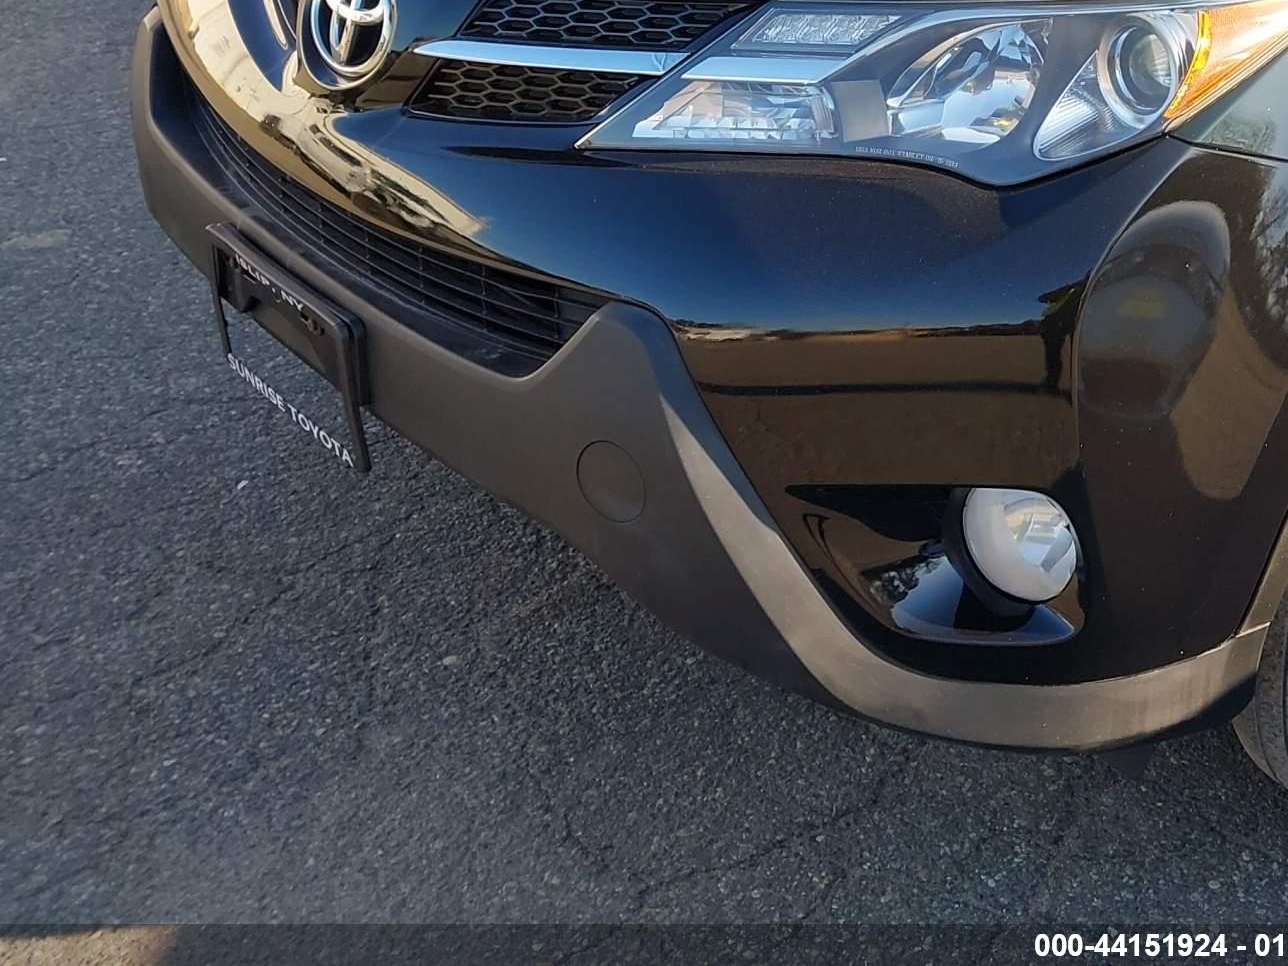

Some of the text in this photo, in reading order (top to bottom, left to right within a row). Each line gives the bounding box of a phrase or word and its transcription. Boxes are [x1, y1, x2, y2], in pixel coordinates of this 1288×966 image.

[281, 291, 304, 312] NY
[227, 352, 354, 467] SUNRISE TOYOTA
